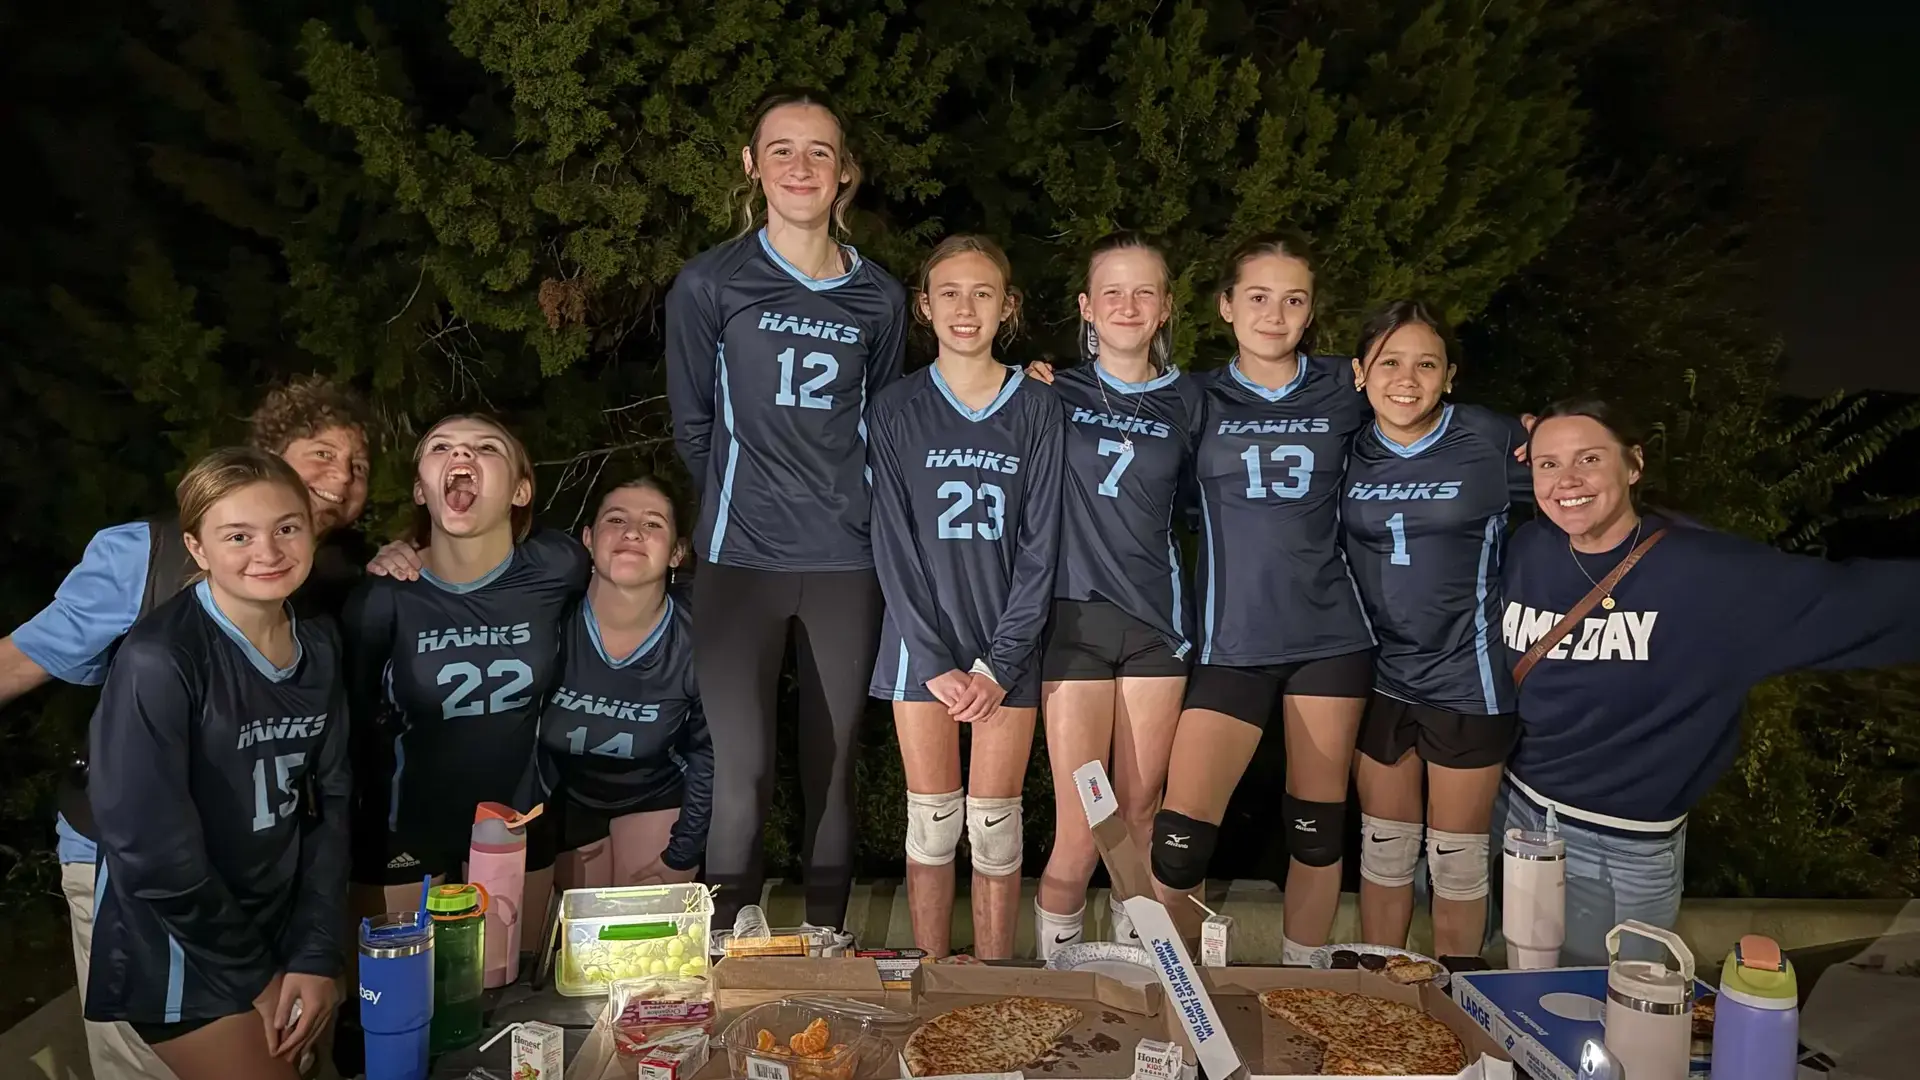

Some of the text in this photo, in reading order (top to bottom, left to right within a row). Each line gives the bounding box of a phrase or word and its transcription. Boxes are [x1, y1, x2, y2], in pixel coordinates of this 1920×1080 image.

[758, 311, 861, 344] HAWKS
[775, 347, 840, 410] 12
[1071, 406, 1171, 439] HAWKS
[1217, 417, 1330, 435] HAWKS
[925, 448, 1020, 475] HAWKS
[1097, 438, 1135, 498] 7
[1240, 444, 1315, 499] 13
[1347, 480, 1463, 501] HAWKS
[937, 481, 1006, 541] 23
[1385, 512, 1411, 566] 1
[417, 622, 531, 653] HAWKS
[436, 658, 534, 720] 22
[551, 686, 661, 722] HAWKS
[237, 713, 328, 750] HAWKS
[566, 726, 635, 760] 14
[252, 752, 306, 832] 15
[387, 859, 421, 869] adidas
[1151, 938, 1178, 981] DOMINO'S
[1171, 982, 1187, 999] SAY
[1174, 965, 1196, 997] SAYING
[1190, 998, 1215, 1037] WITHOUT
[1460, 990, 1492, 1033] LARGE
[514, 1035, 541, 1050] Honest
[1193, 1025, 1208, 1044] YOU
[1140, 1067, 1169, 1078] ORGANIC
